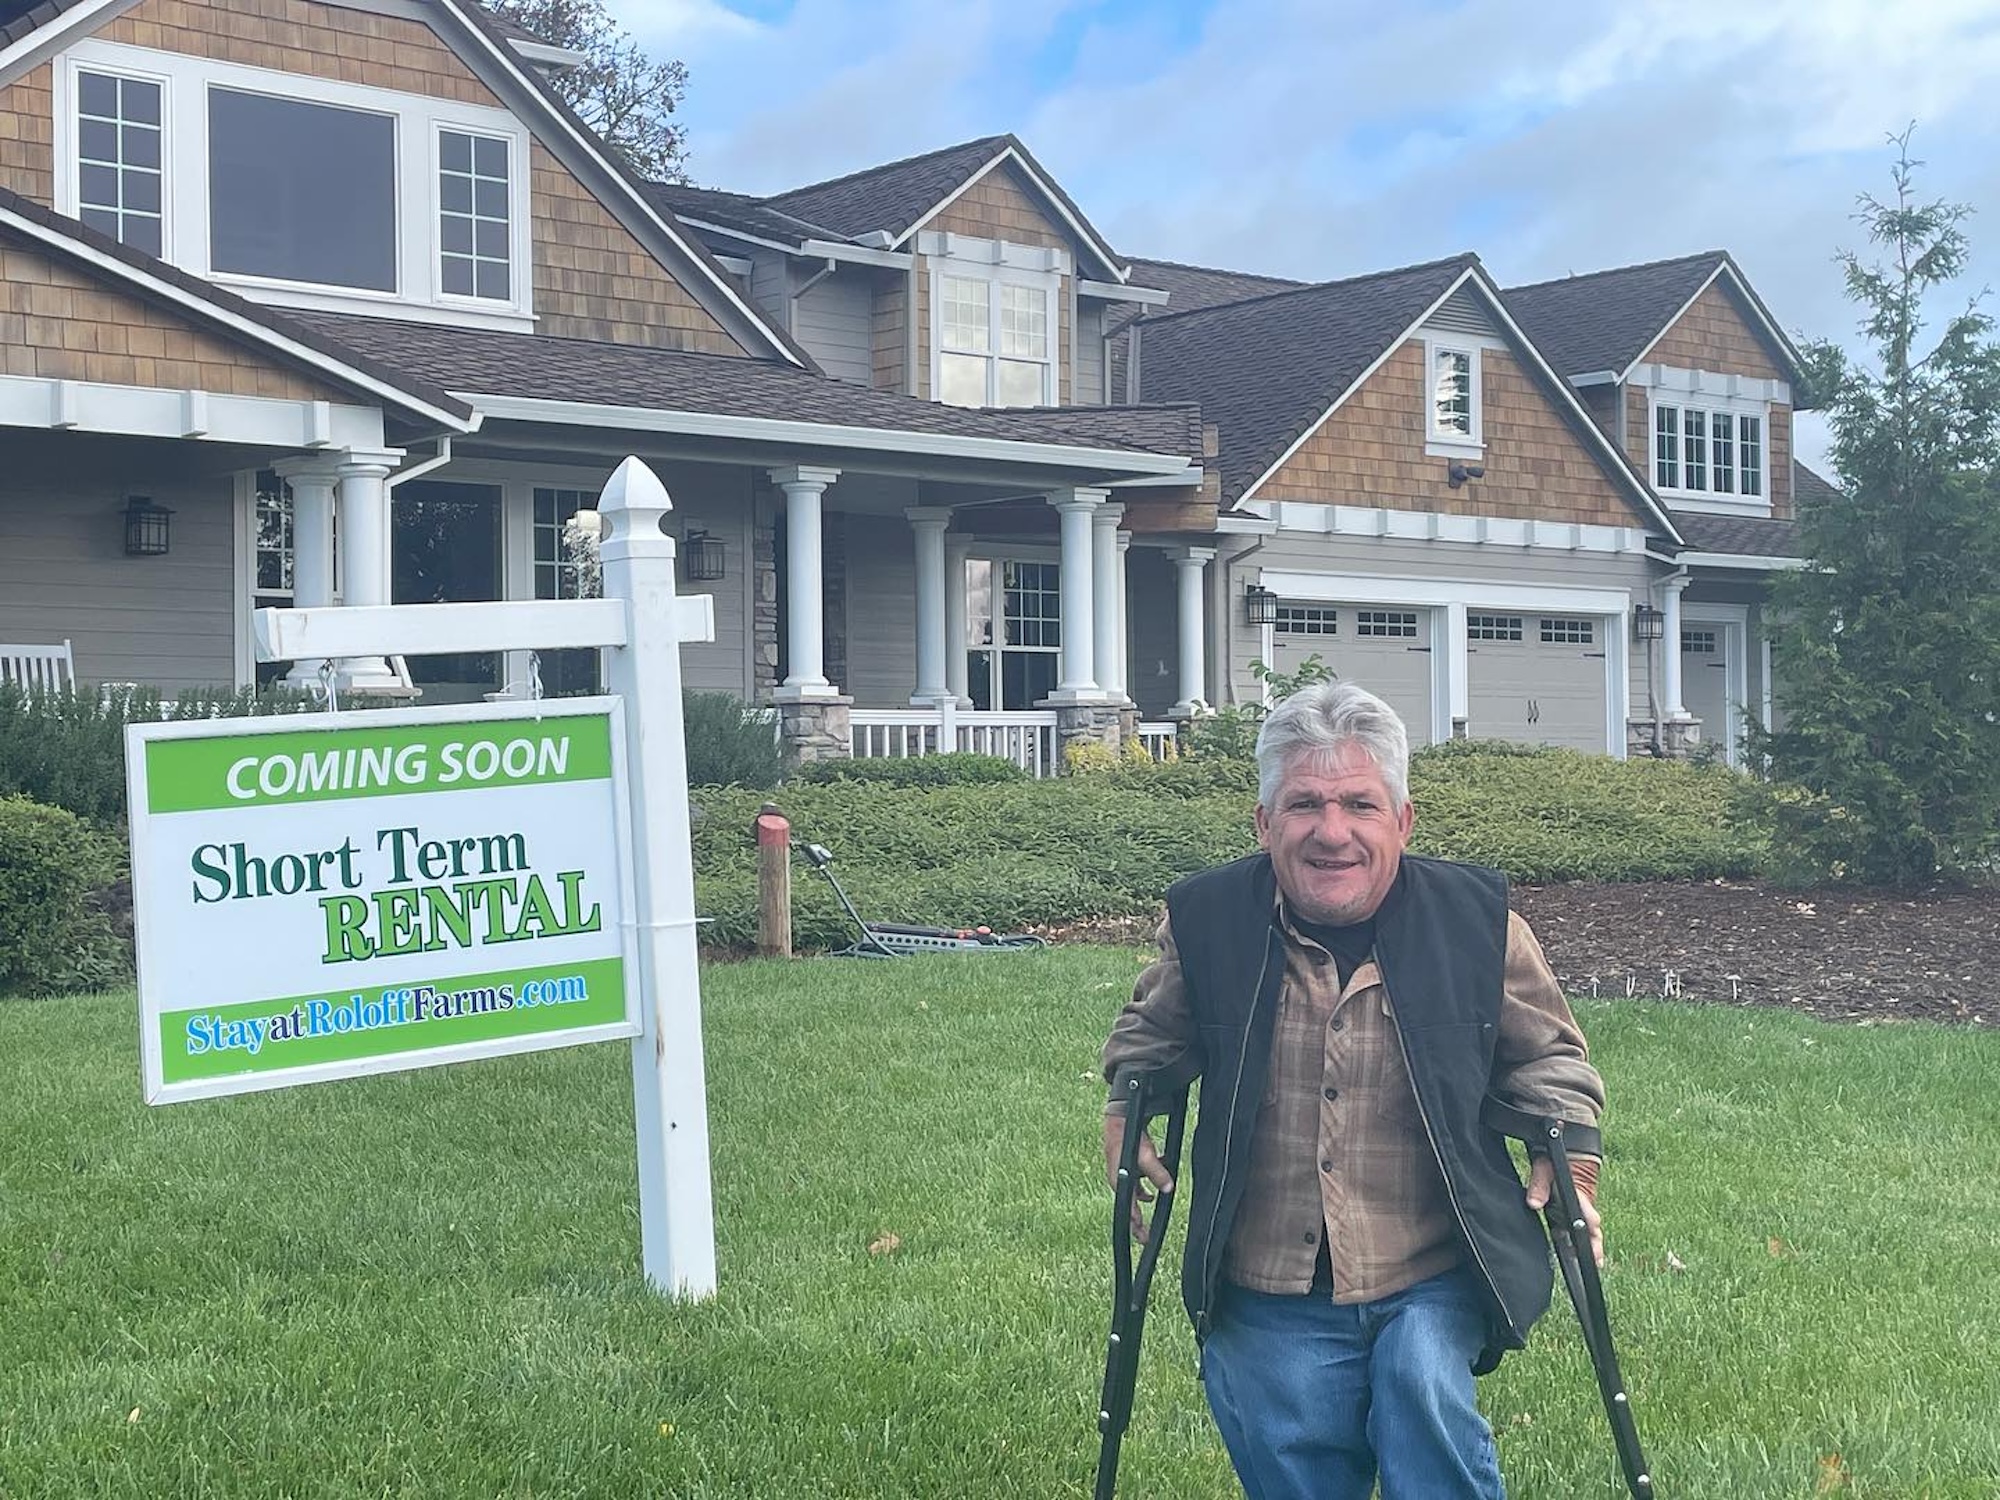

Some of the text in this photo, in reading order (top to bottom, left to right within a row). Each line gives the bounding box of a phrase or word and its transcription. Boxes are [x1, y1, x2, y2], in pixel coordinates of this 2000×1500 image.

[226, 736, 570, 799] COMING SOON
[191, 827, 531, 903] Short Term
[319, 870, 601, 965] RENTAL
[185, 974, 588, 1055] StayatRoloffFarms.com
